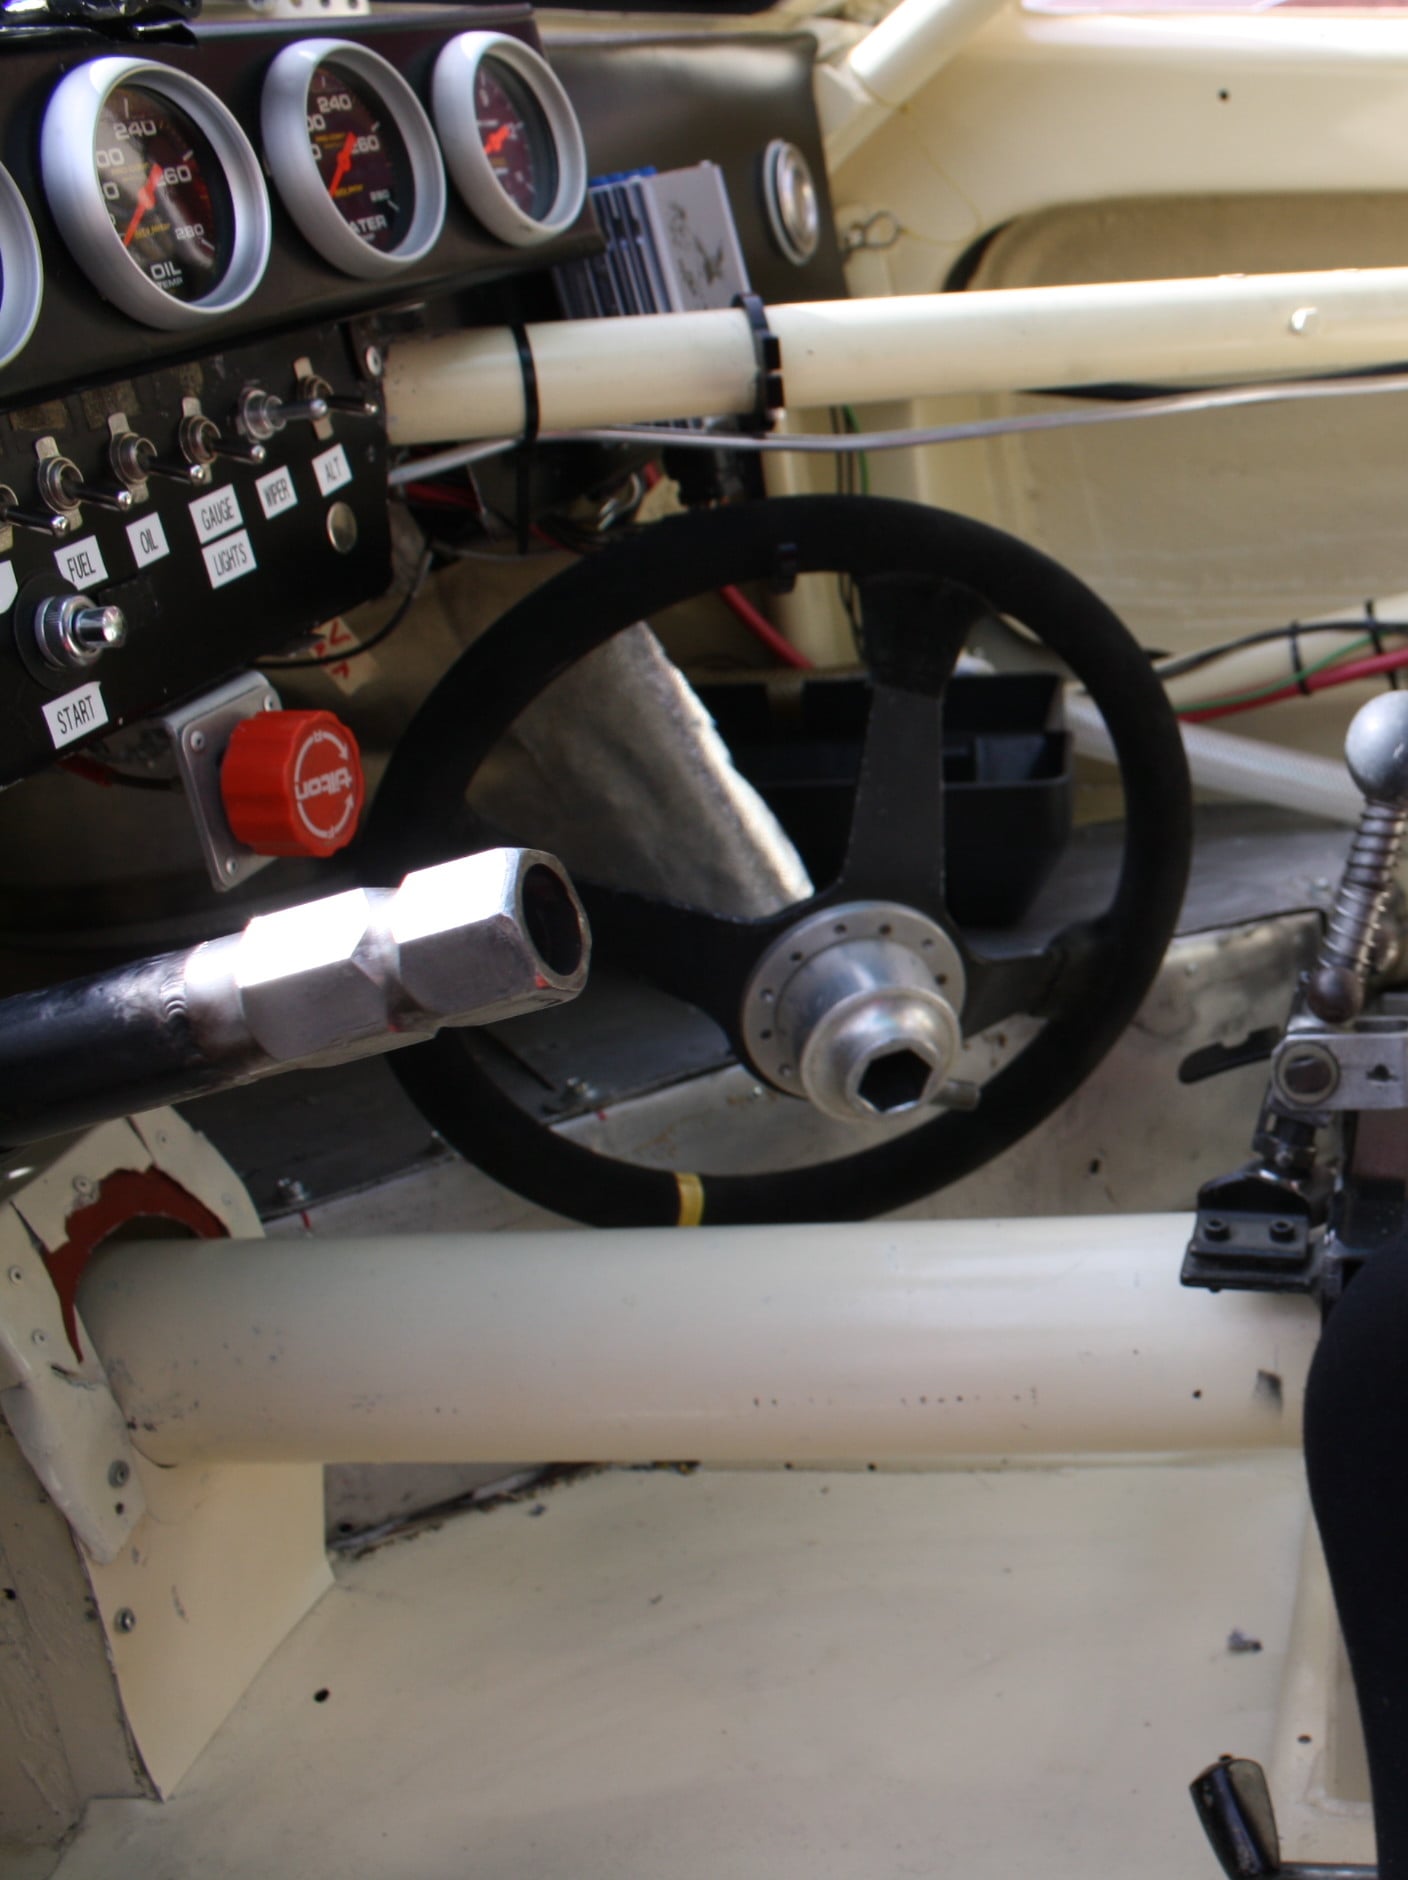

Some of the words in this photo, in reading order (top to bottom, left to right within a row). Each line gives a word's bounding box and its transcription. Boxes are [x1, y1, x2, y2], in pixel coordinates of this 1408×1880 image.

[317, 94, 352, 113] 240
[113, 120, 157, 140] 240
[350, 214, 387, 234] ATER
[151, 261, 182, 280] OIL
[323, 455, 342, 484] ALT
[263, 477, 291, 508] WIPER
[200, 497, 235, 531] GAUGE
[140, 528, 159, 554] OIL
[67, 551, 96, 582] FUEL
[213, 542, 248, 577] LIGHTS
[56, 695, 95, 734] START
